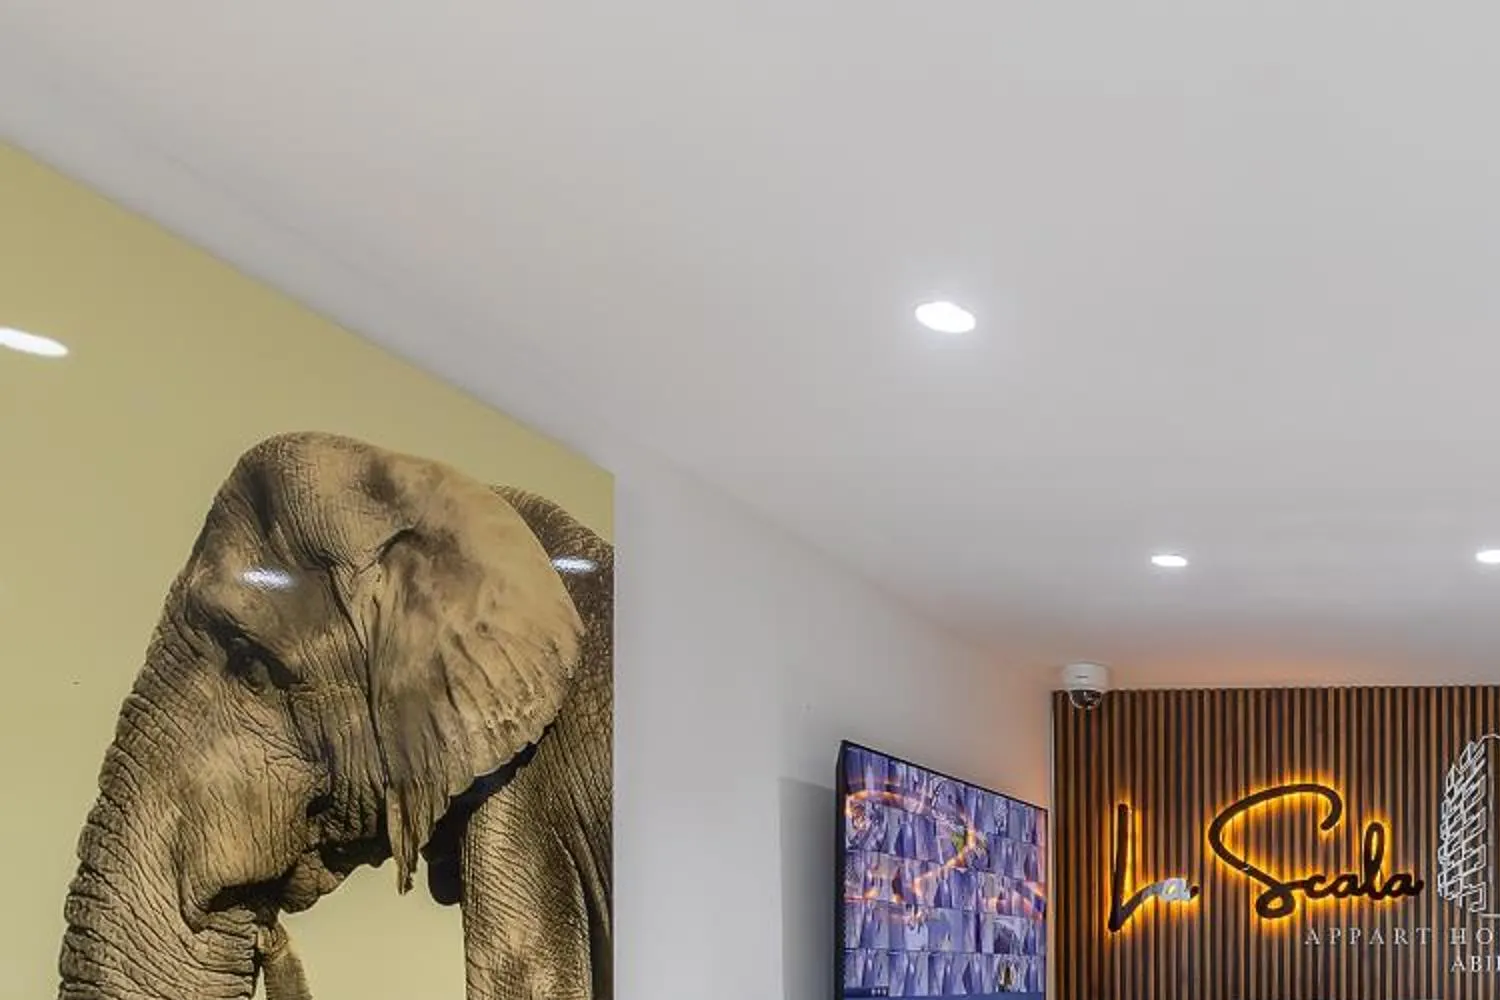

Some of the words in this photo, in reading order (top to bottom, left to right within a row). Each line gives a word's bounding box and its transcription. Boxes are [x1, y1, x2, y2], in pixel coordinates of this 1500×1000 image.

[1107, 803, 1200, 932] La
[1207, 783, 1425, 919] Scala
[1304, 927, 1432, 946] APPART
